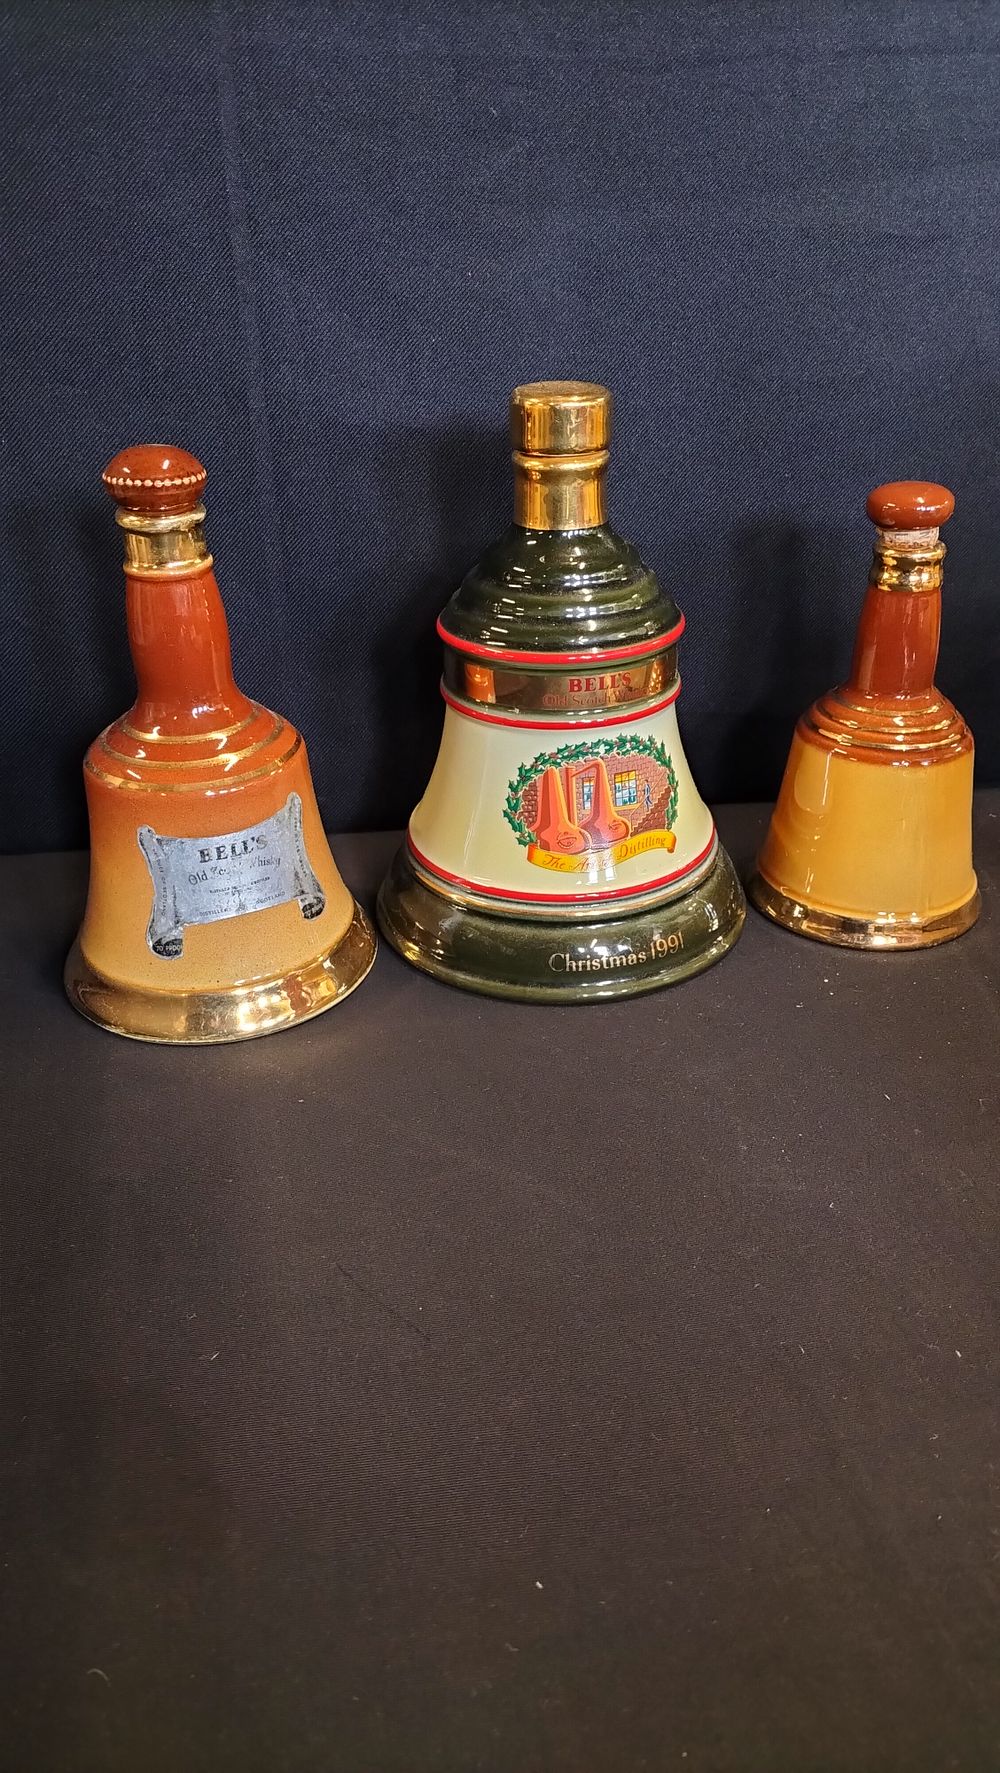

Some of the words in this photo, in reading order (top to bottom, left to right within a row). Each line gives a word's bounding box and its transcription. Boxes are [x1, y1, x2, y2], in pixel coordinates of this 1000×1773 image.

[567, 672, 632, 693] BELL'S
[543, 693, 568, 707] Old
[571, 690, 611, 707] Scotch
[197, 834, 269, 864] BELL'S
[541, 854, 565, 869] The
[569, 856, 595, 871] Ar
[616, 836, 667, 861] Distilling
[188, 869, 209, 886] Old
[254, 891, 286, 905] SCOTLAND
[549, 949, 647, 972] Christmas
[650, 931, 684, 960] 1991
